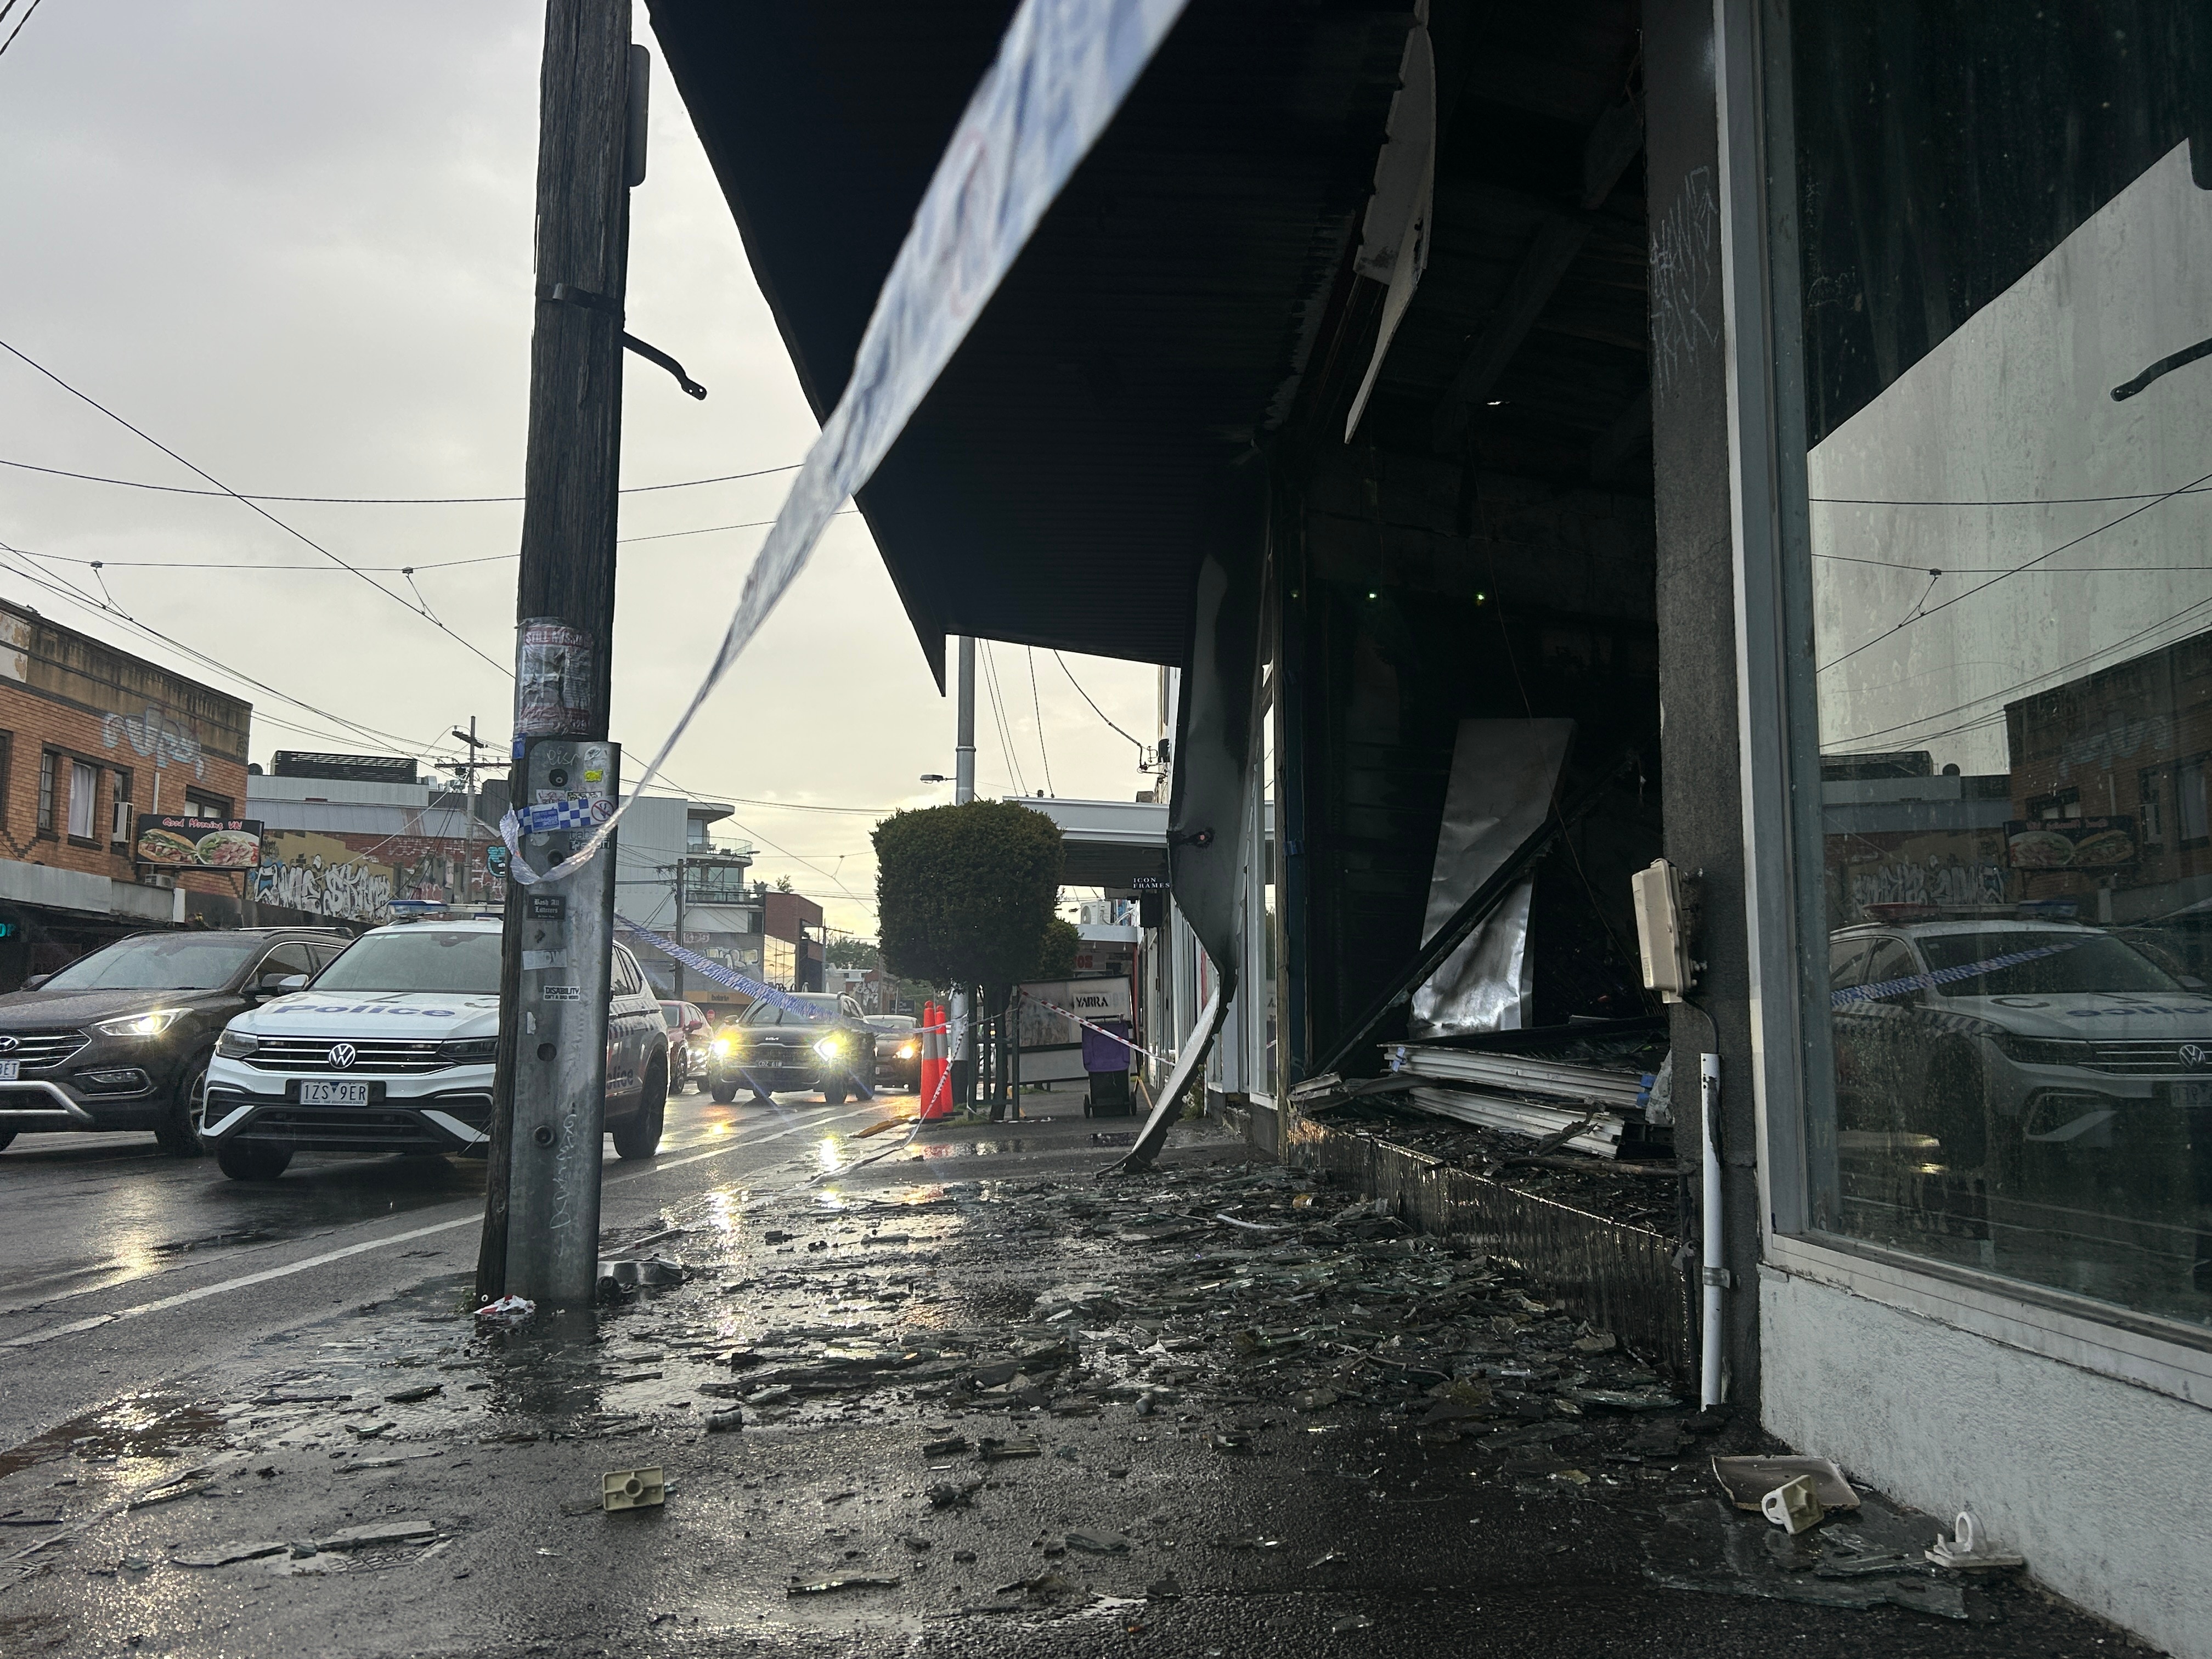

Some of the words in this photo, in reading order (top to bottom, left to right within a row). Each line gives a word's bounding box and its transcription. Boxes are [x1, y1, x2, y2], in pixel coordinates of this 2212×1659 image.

[162, 817, 184, 827] Good
[189, 818, 223, 830] Morning
[228, 821, 242, 830] VN
[1076, 996, 1109, 1007] YARRA
[273, 1005, 455, 1017] Police
[606, 1065, 634, 1090] olice
